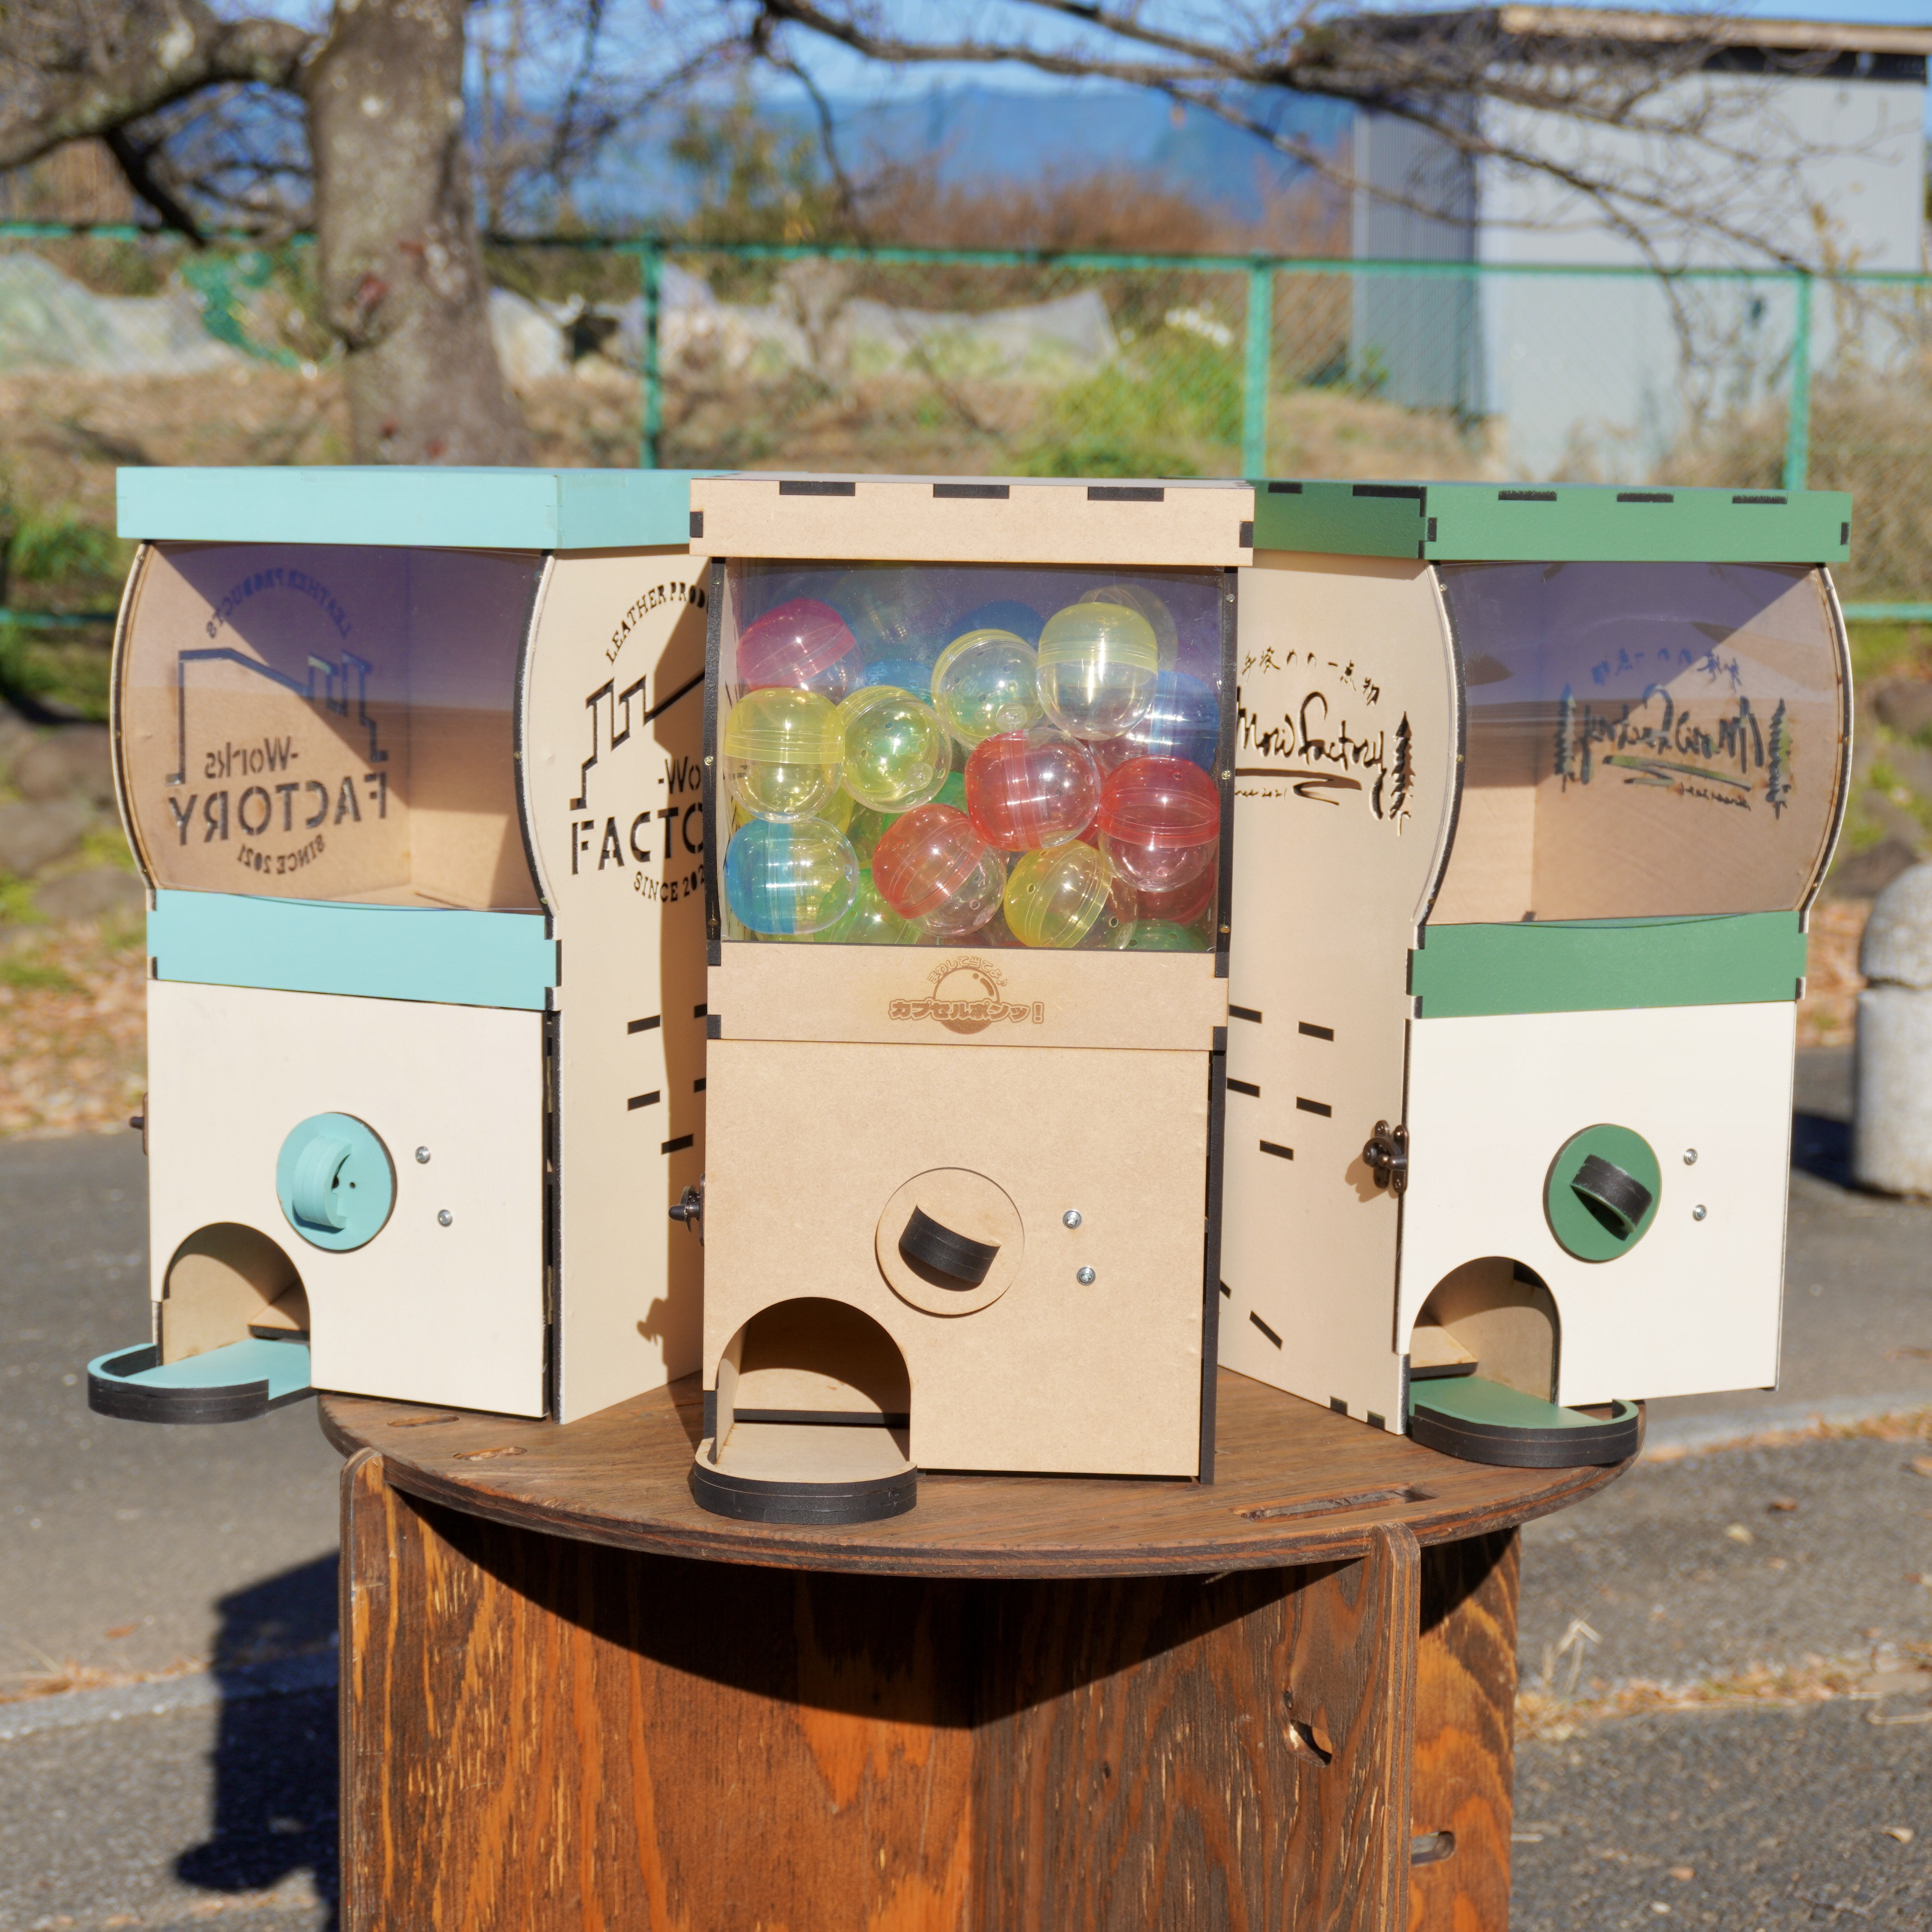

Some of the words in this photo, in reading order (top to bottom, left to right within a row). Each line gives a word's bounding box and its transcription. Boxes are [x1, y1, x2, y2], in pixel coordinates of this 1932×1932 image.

[605, 584, 666, 665] LEATHER
[634, 870, 678, 902] SINCE
[682, 864, 705, 898] 202
